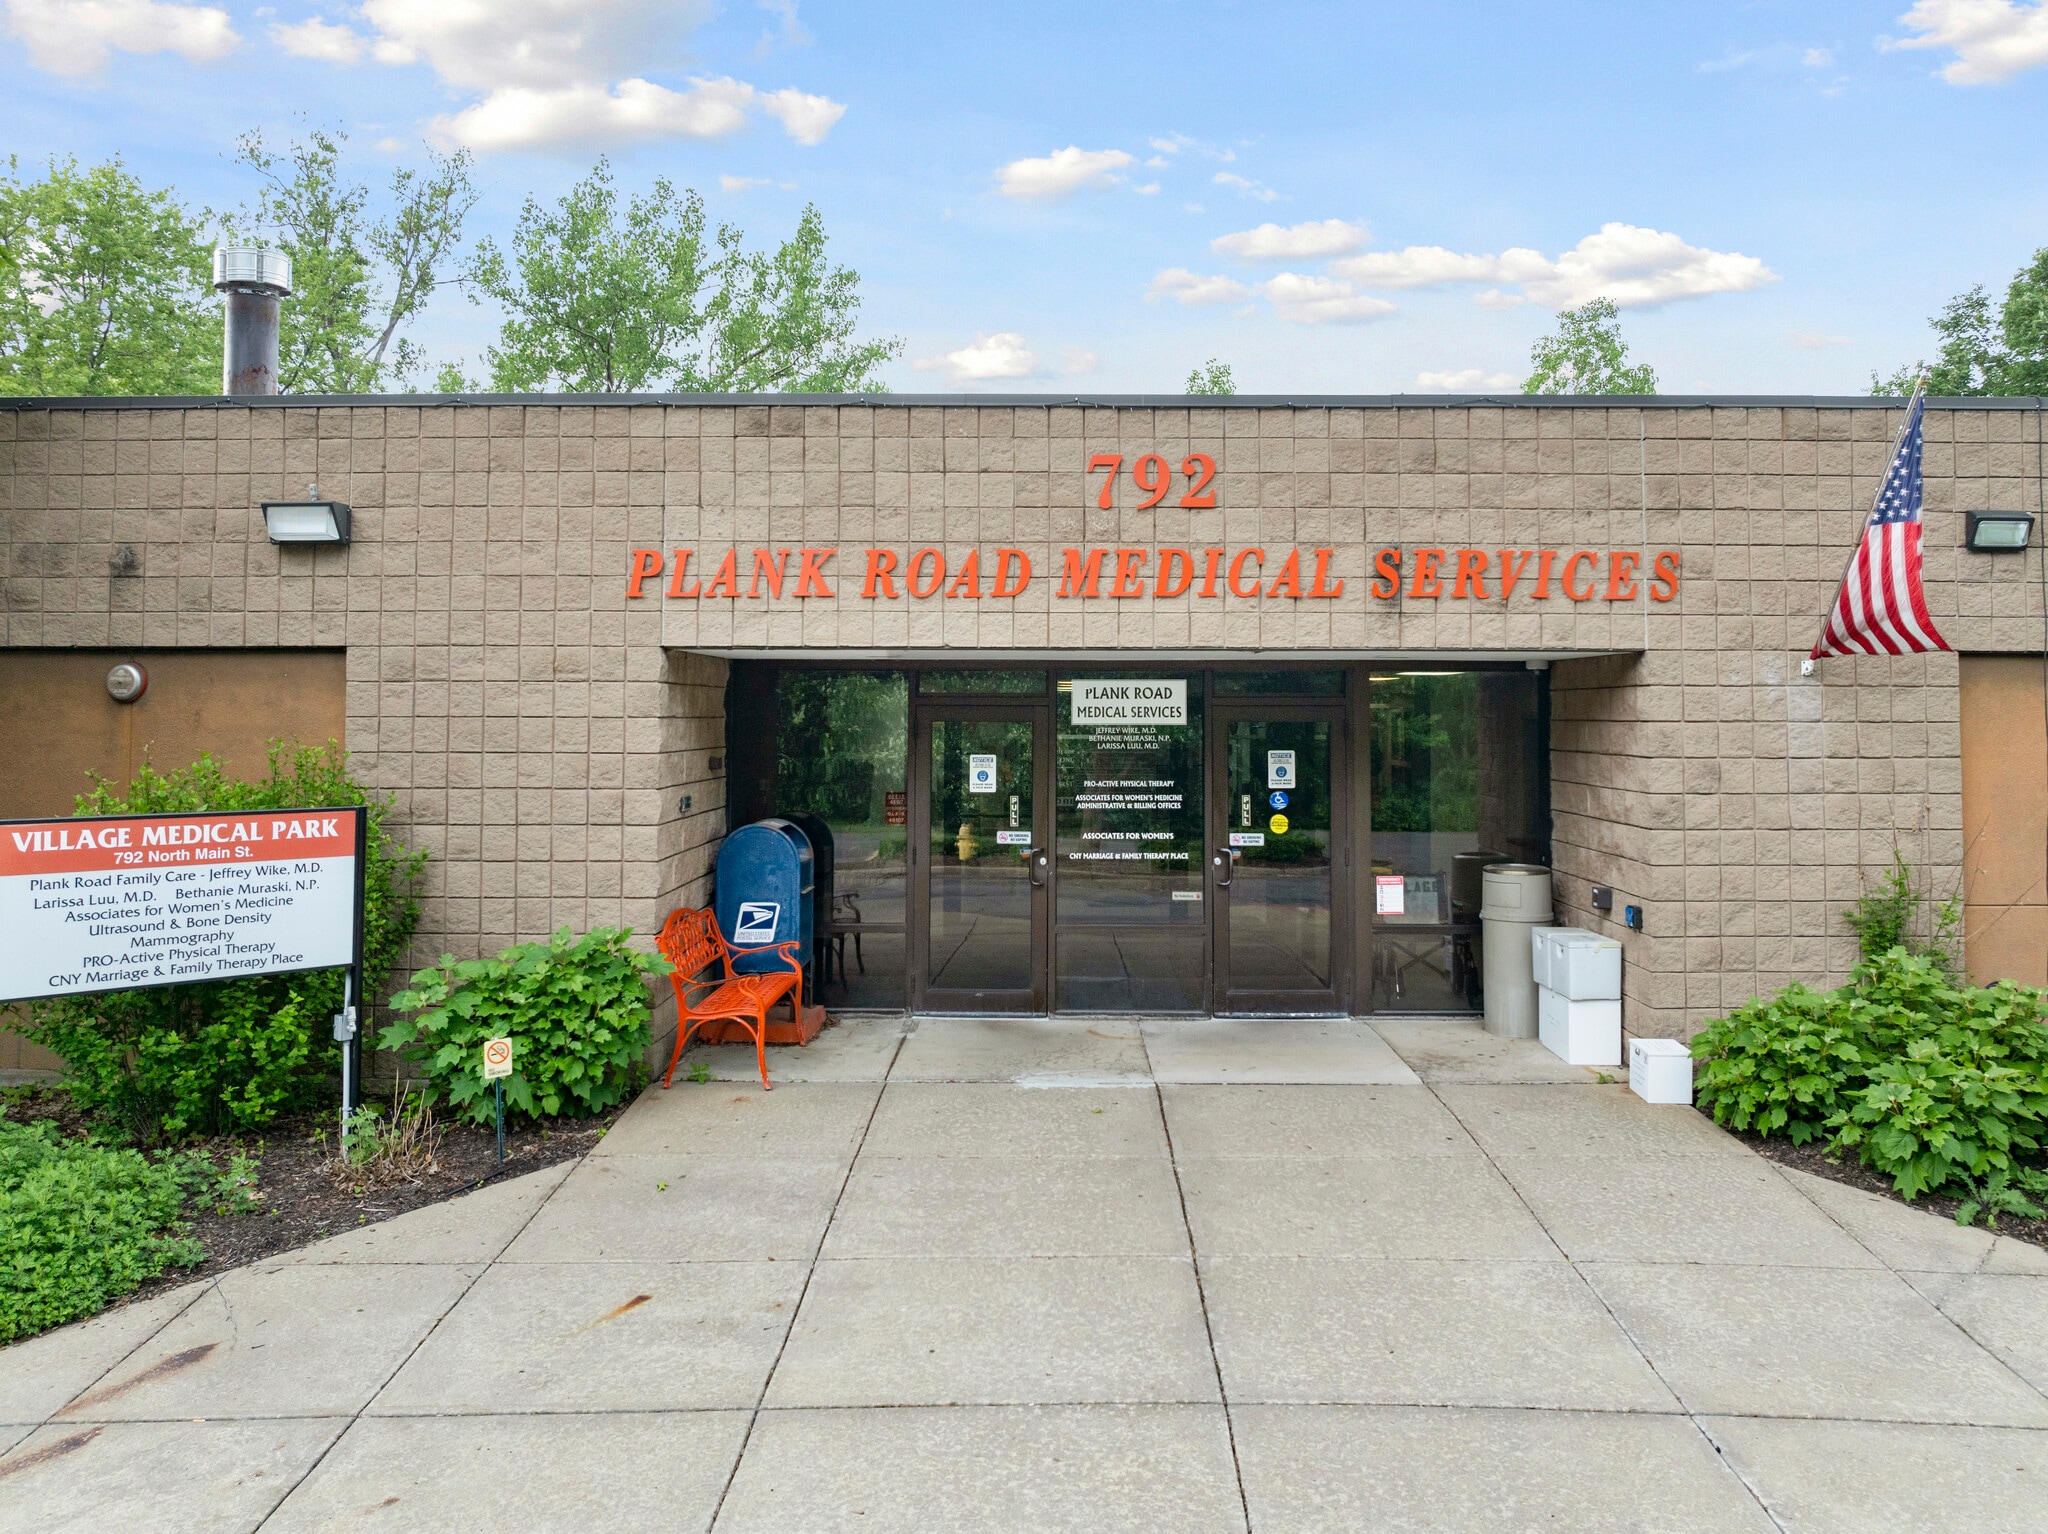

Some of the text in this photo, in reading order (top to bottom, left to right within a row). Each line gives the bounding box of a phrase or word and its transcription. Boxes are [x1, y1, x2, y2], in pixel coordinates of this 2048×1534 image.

[1086, 454, 1217, 509] 792
[625, 547, 1681, 601] PLANK ROAD MEDICAL SERVICES
[1085, 687, 1172, 699] PLANK ROAD
[1077, 706, 1182, 718] MEDICAL SERVICES
[11, 818, 339, 852] VILLAGE MEDICAL PARK
[114, 846, 253, 865] 792 North Main St.
[30, 878, 70, 891] Plank
[75, 875, 112, 888] Road
[116, 872, 161, 886] Family
[165, 870, 196, 882] Care
[208, 867, 252, 882] Jeffrey
[255, 865, 290, 876] Wike,
[294, 862, 323, 874] M.D.
[34, 879, 320, 910] Larissa Luu, M.D. Bethanie Muraski, N.P.
[64, 896, 294, 922] Associates for Women's Medicine
[89, 912, 272, 936] Ultrasound & Bone Density
[130, 930, 234, 948] Mammography
[83, 942, 276, 968] PRO-Active Physical Therapy
[49, 953, 304, 986] CNY Marriage & Family Therapy Place
